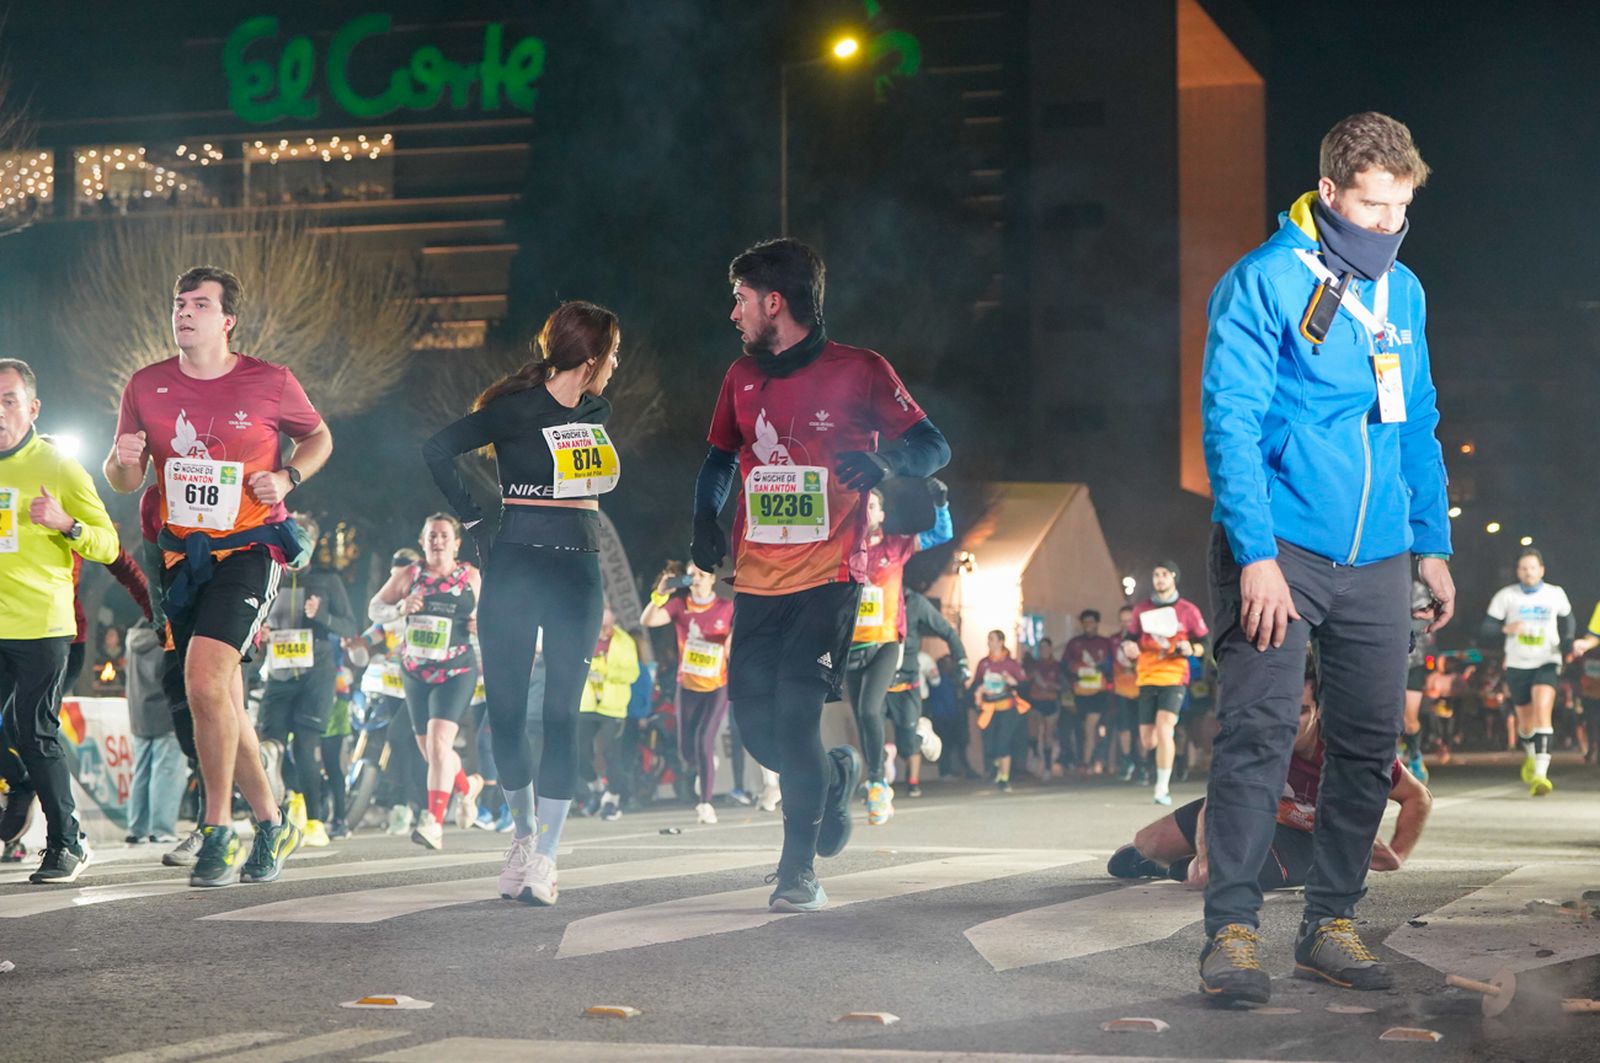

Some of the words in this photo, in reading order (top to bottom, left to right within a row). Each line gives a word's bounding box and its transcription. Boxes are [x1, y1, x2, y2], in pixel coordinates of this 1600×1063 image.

[223, 16, 318, 122] El
[327, 13, 546, 117] Corte
[562, 431, 582, 440] NOCHE
[582, 430, 589, 438] DE
[557, 440, 571, 449] SAN
[572, 448, 602, 471] 874
[182, 466, 204, 475] NOCHE
[173, 473, 187, 481] SAN
[763, 474, 785, 482] NOCHE
[787, 474, 796, 482] DE
[508, 484, 554, 496] NIKE
[754, 484, 769, 492] SAN
[185, 484, 219, 506] 618
[760, 494, 813, 517] 9236
[860, 602, 874, 613] 53
[105, 735, 133, 768] SA
[117, 772, 134, 805] A
